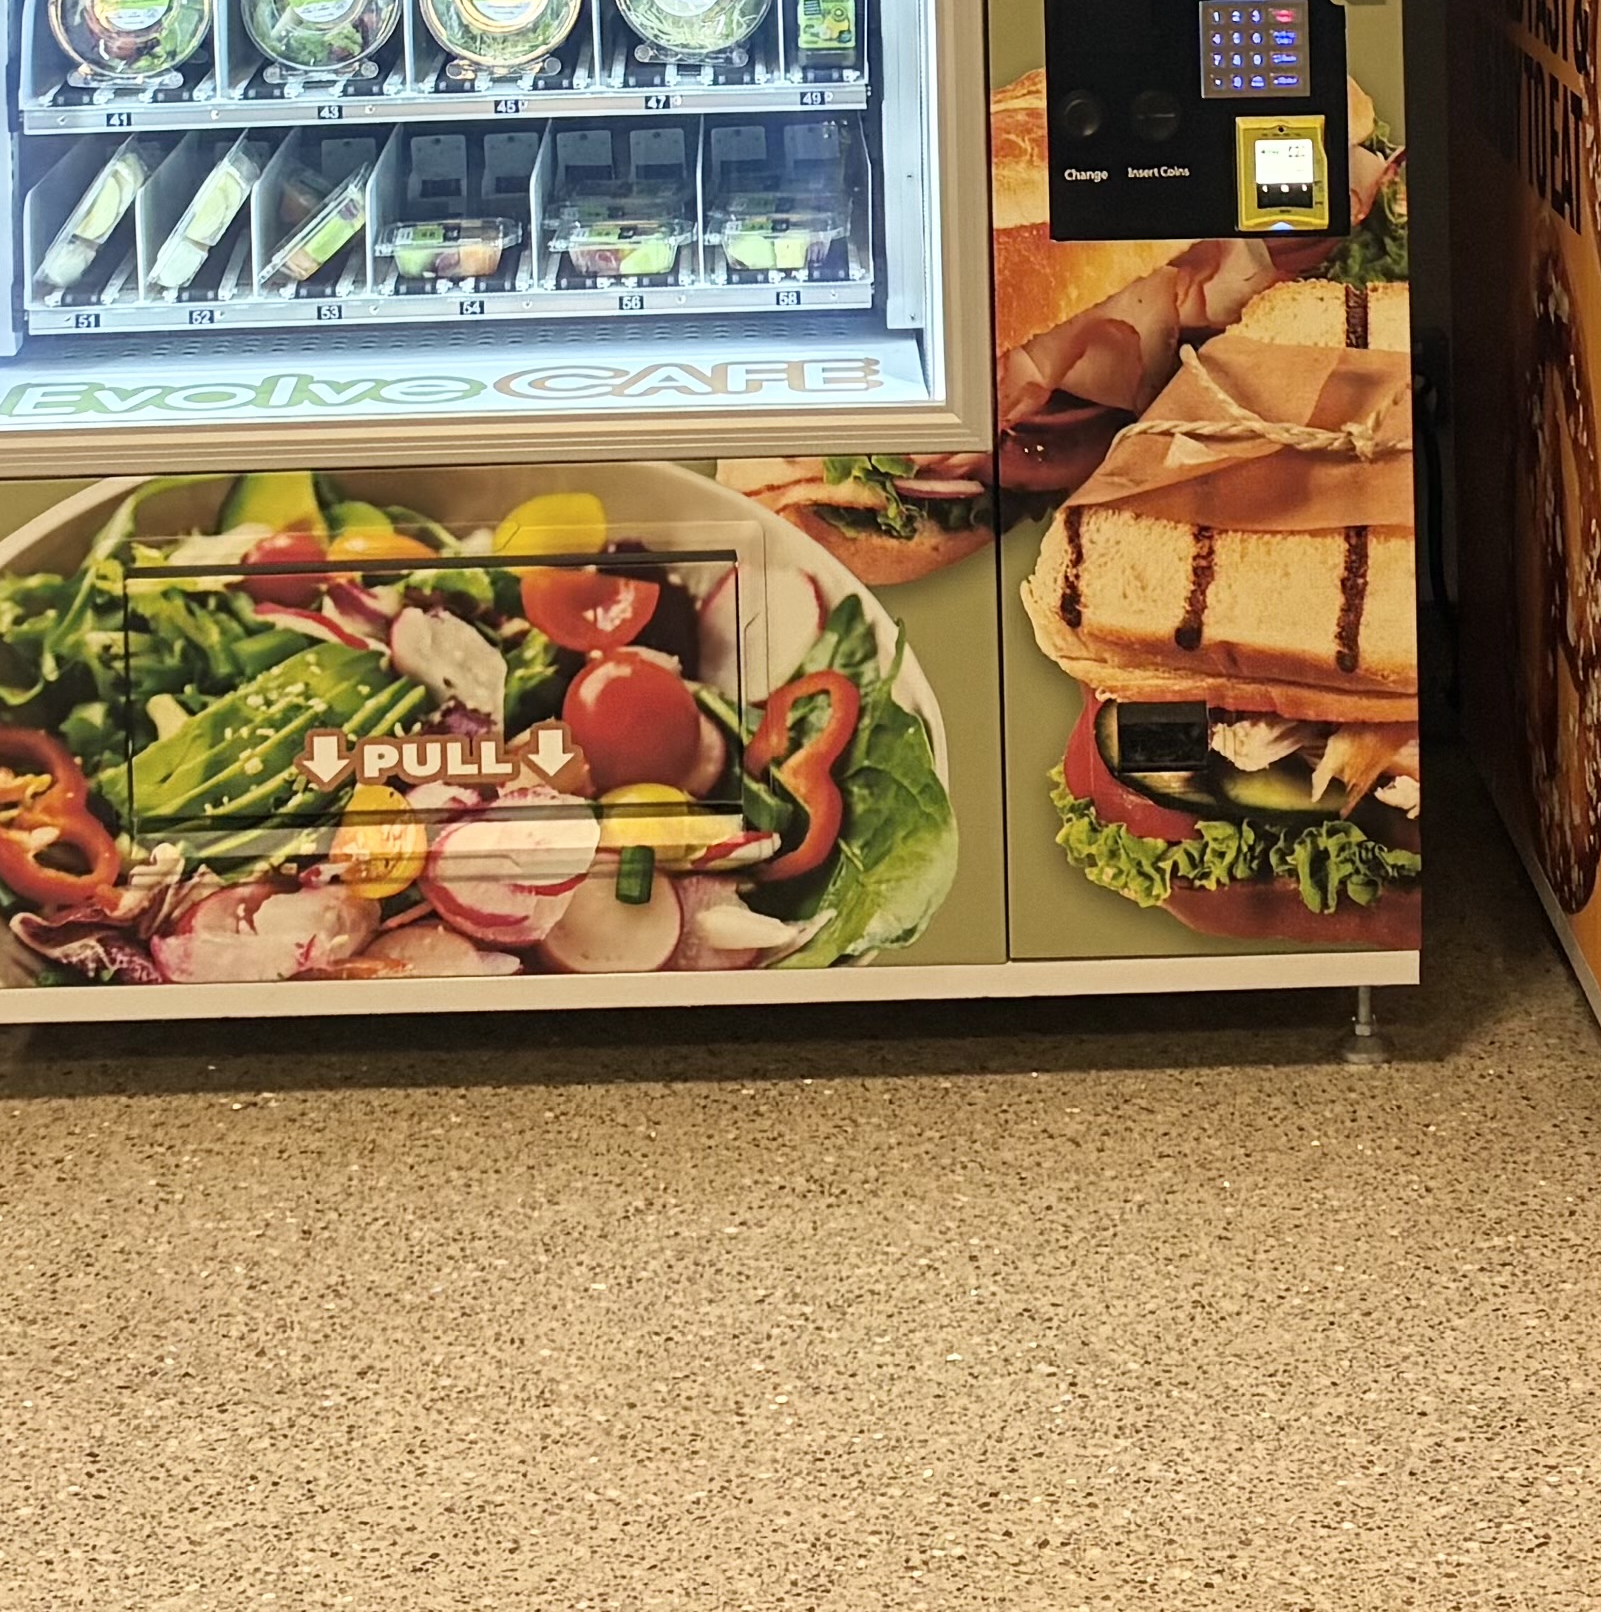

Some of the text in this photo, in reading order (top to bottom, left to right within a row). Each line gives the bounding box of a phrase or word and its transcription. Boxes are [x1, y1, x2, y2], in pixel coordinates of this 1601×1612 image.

[647, 96, 667, 108] 47
[803, 92, 822, 104] 49
[497, 101, 516, 113] 45
[109, 113, 129, 125] 41
[1064, 168, 1108, 182] Change
[1127, 166, 1190, 178] Insert Coins
[622, 296, 642, 309] 56
[779, 292, 798, 305] 58
[320, 306, 339, 318] 53
[462, 301, 482, 314] 54
[78, 315, 97, 327] 51
[192, 310, 211, 323] 52
[2, 358, 881, 418] Evolve CAFE
[363, 740, 513, 778] PULL
